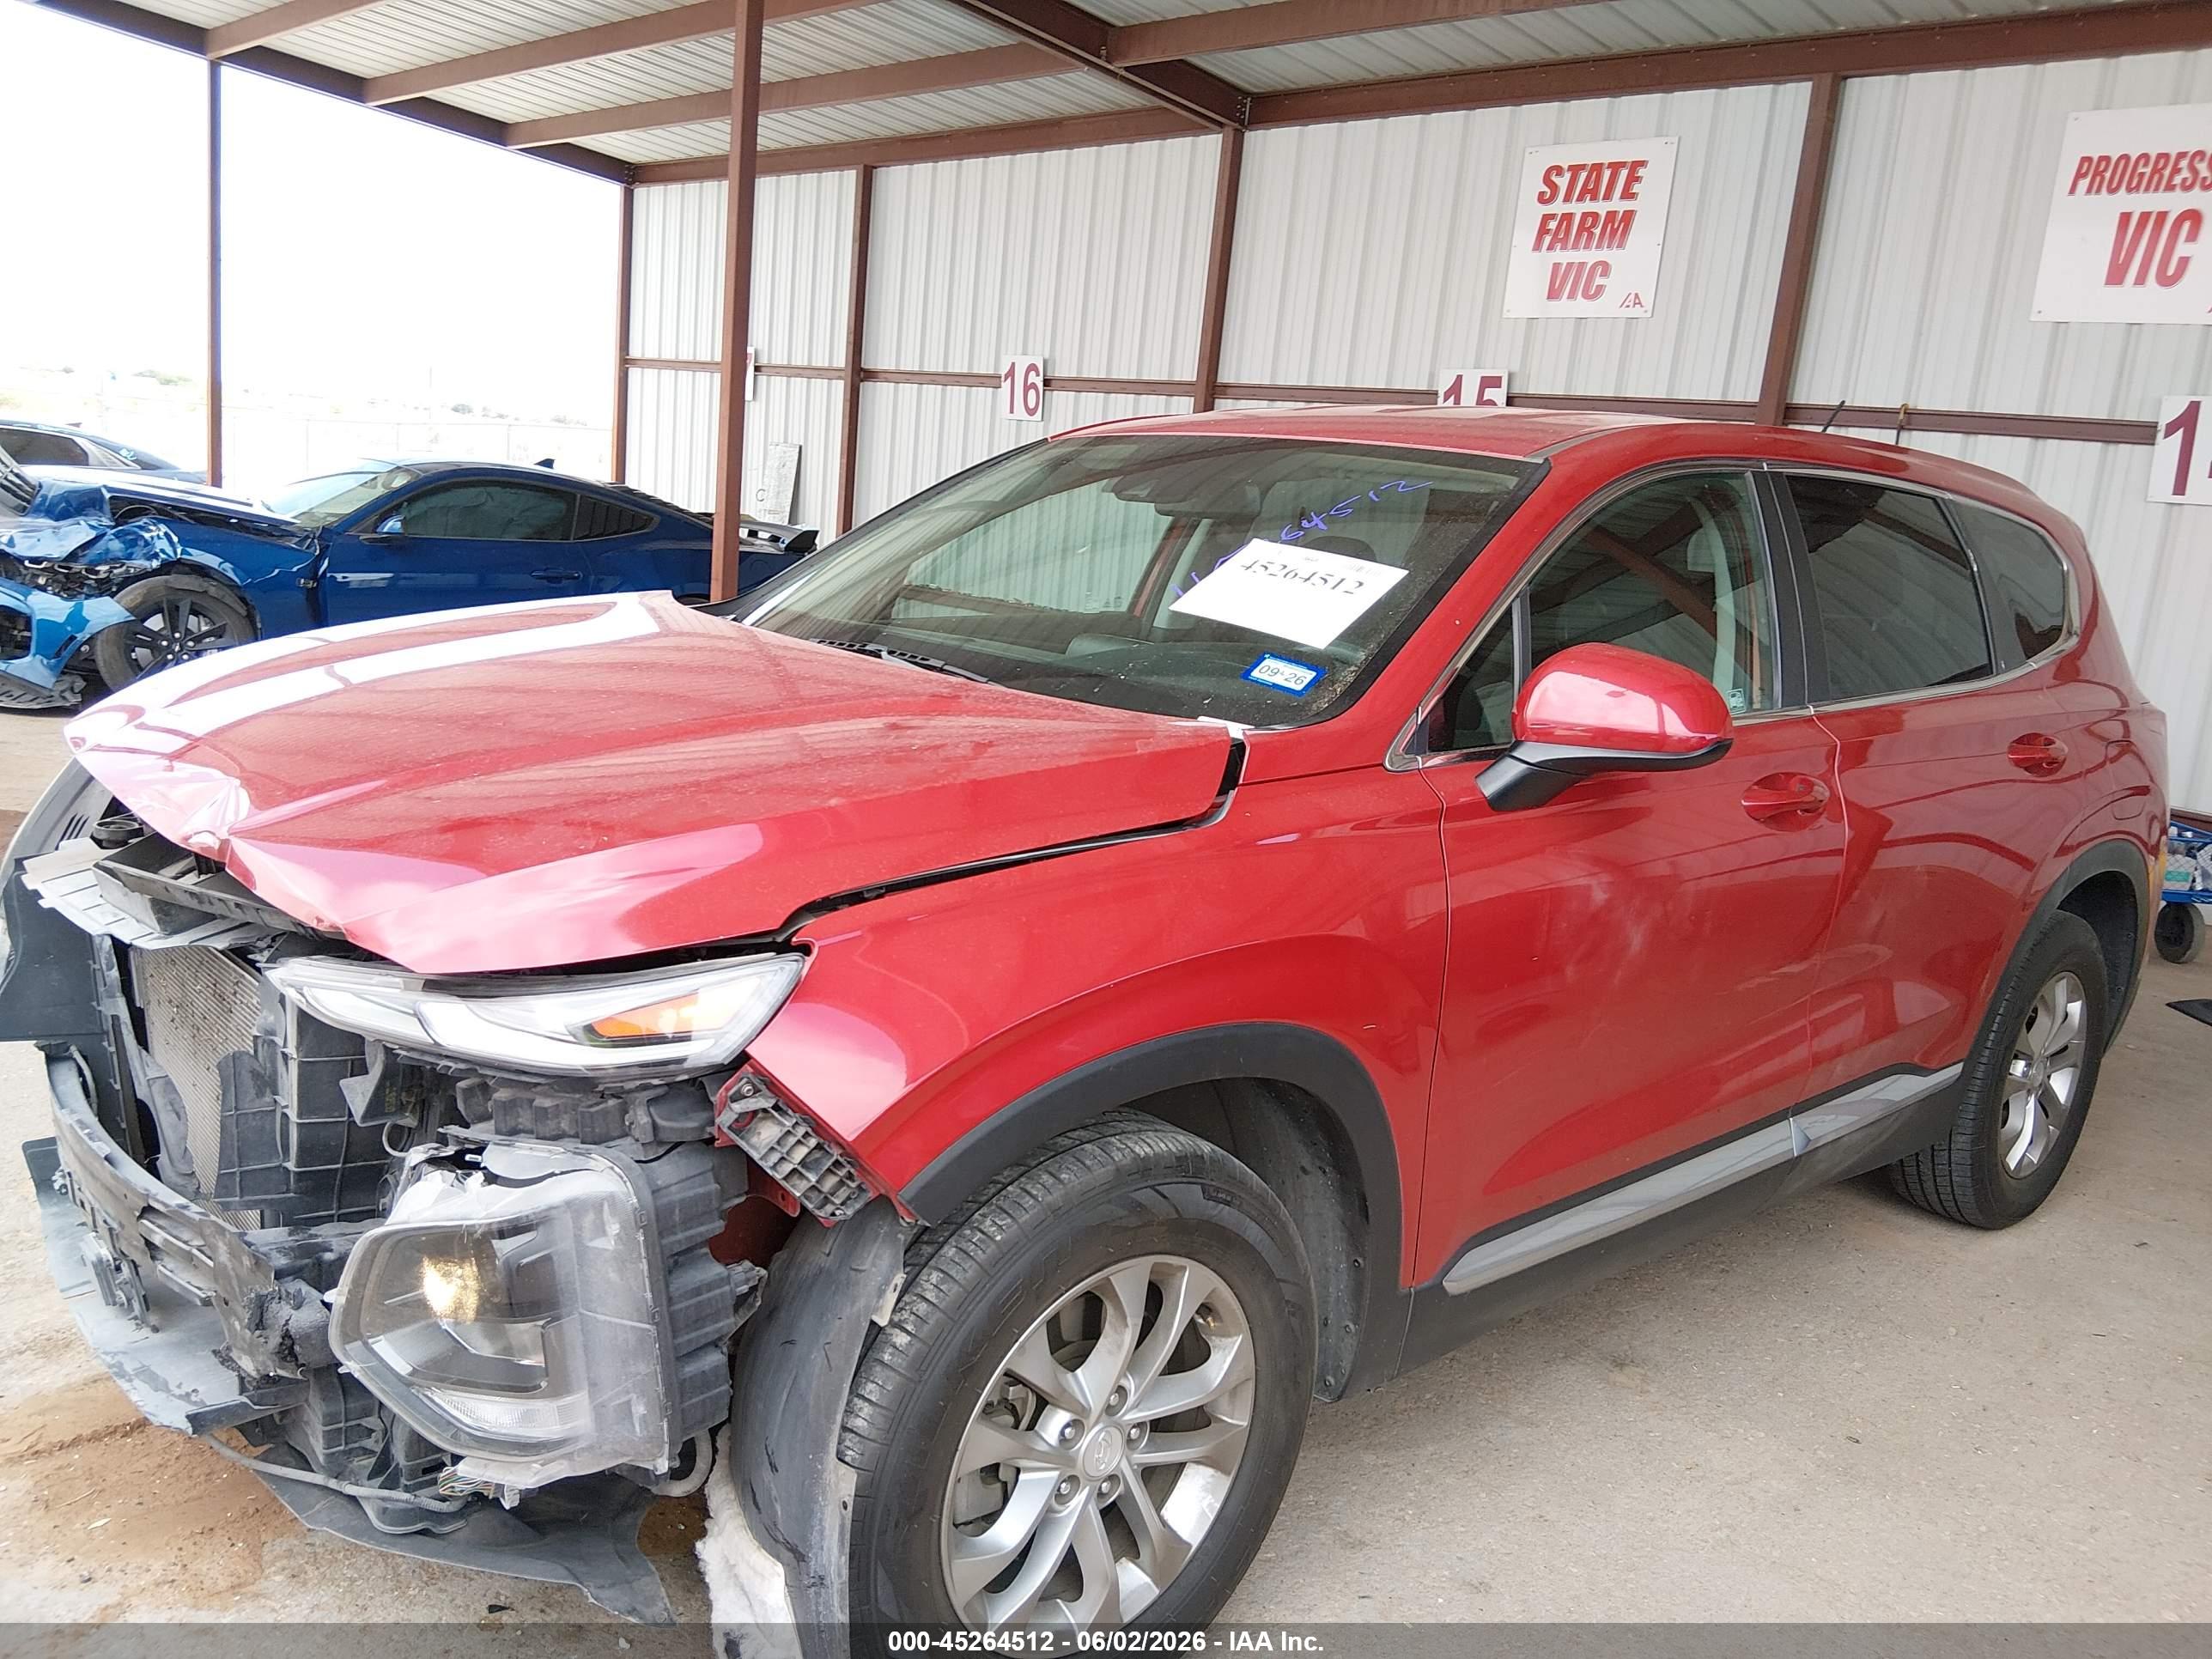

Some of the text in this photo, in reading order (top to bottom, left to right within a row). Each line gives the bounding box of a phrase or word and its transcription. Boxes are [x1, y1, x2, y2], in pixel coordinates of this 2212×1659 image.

[1536, 160, 1649, 206] STATE
[1532, 210, 1638, 252] FARM
[2104, 208, 2203, 289] VIC
[1546, 260, 1612, 301] VIC
[1003, 362, 1041, 417] 16
[2163, 400, 2212, 496] 1
[1241, 559, 1365, 595] 45264512
